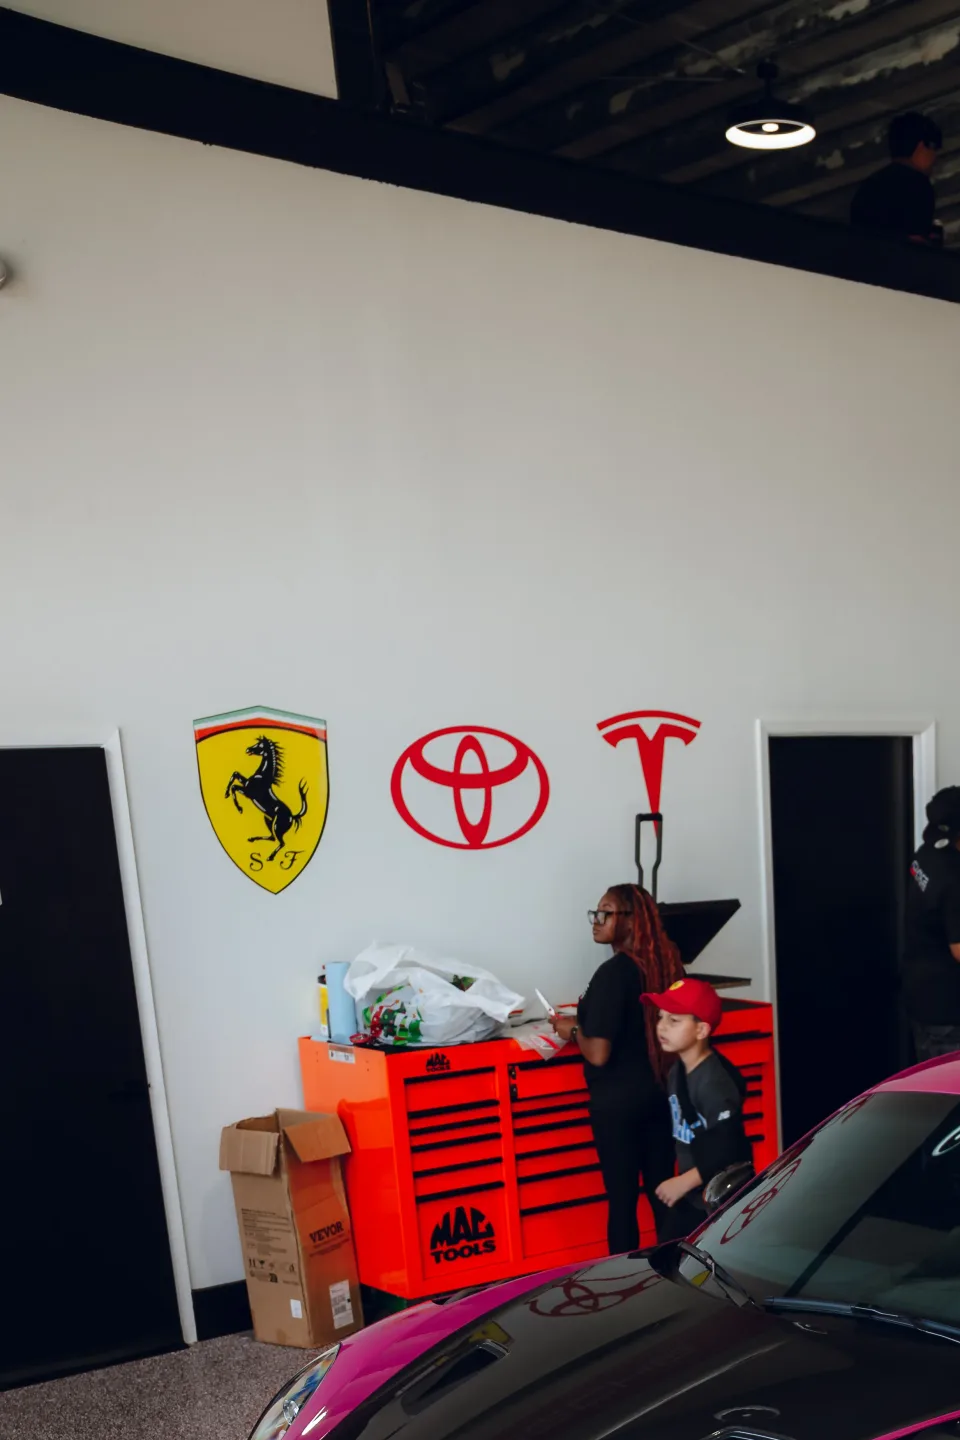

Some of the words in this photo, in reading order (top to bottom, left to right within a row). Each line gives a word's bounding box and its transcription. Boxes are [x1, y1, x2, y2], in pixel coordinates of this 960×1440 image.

[250, 852, 264, 872] S
[309, 1220, 344, 1243] VEVOR
[430, 1205, 495, 1250] MAC
[430, 1240, 496, 1265] TOOLS
